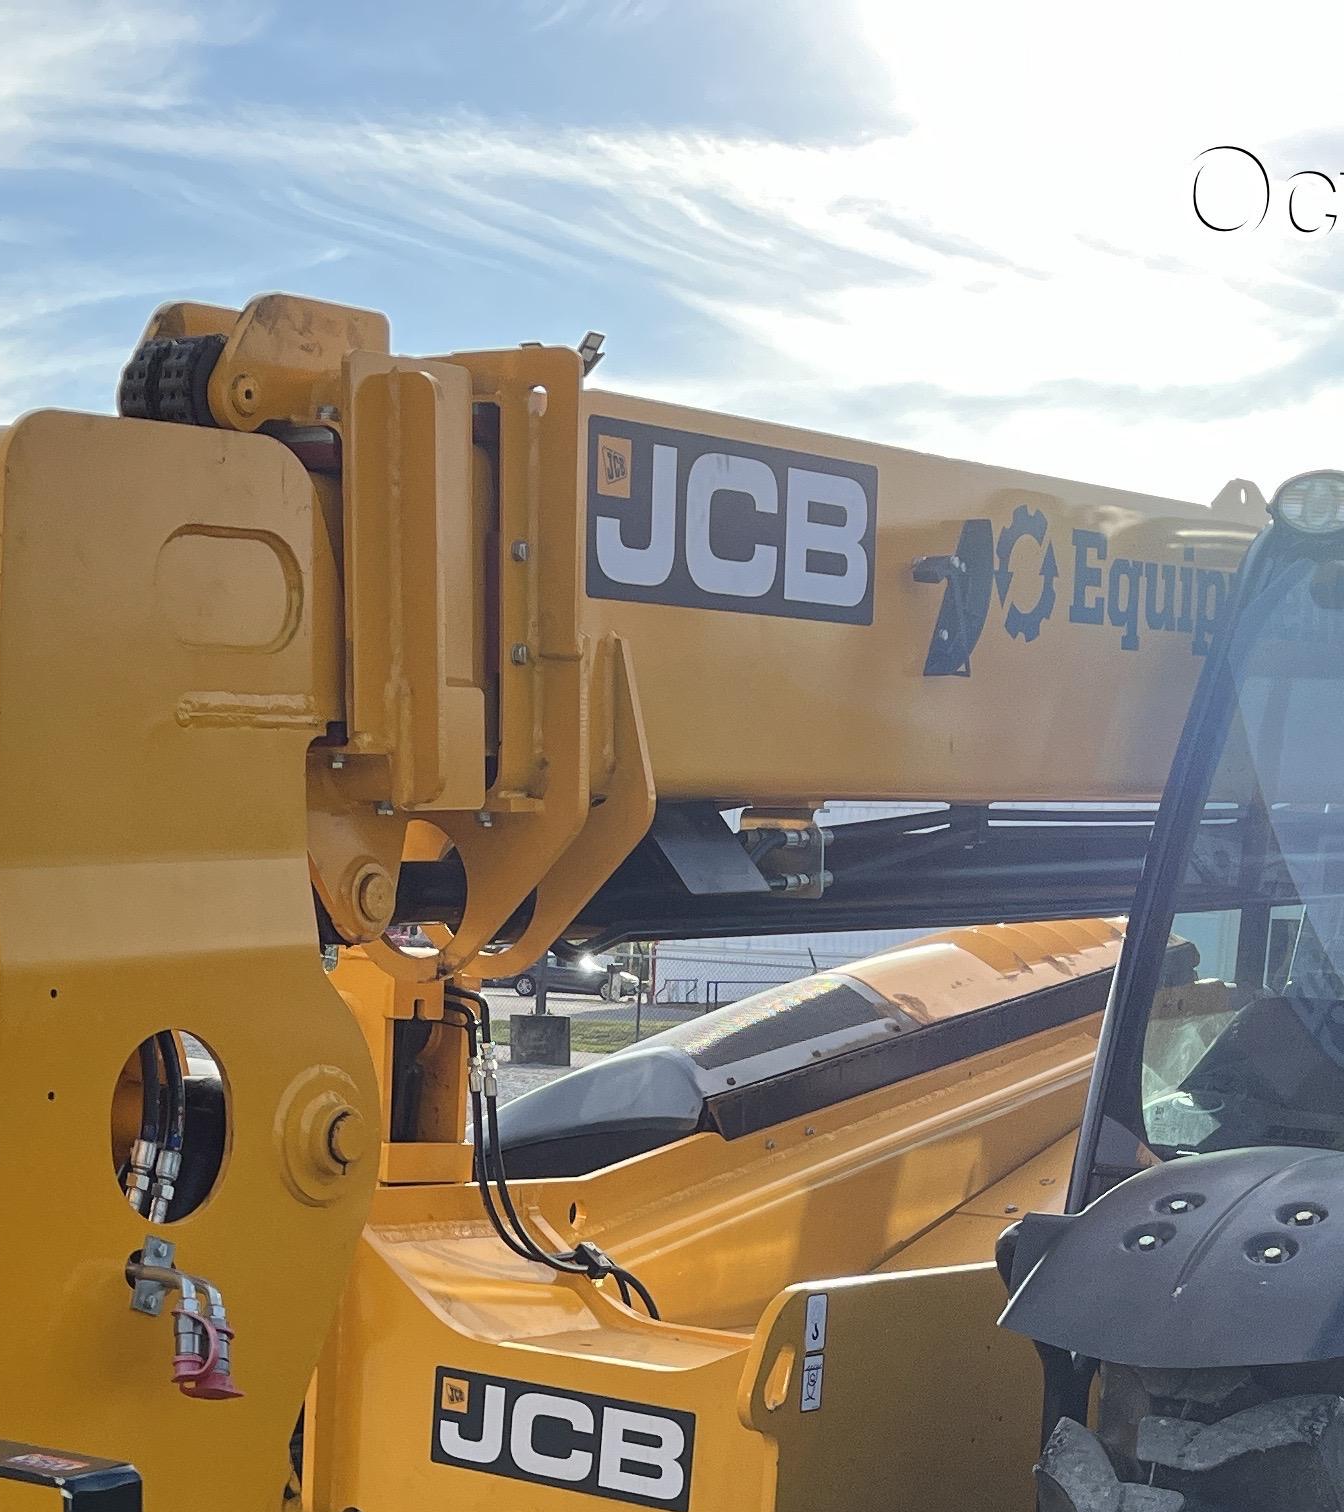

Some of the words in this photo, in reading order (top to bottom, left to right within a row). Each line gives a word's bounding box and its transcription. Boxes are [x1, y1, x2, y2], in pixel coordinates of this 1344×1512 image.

[596, 444, 869, 607] JCB
[606, 451, 627, 481] JCB
[1069, 528, 1241, 656] Equip
[439, 1384, 685, 1500] JCB
